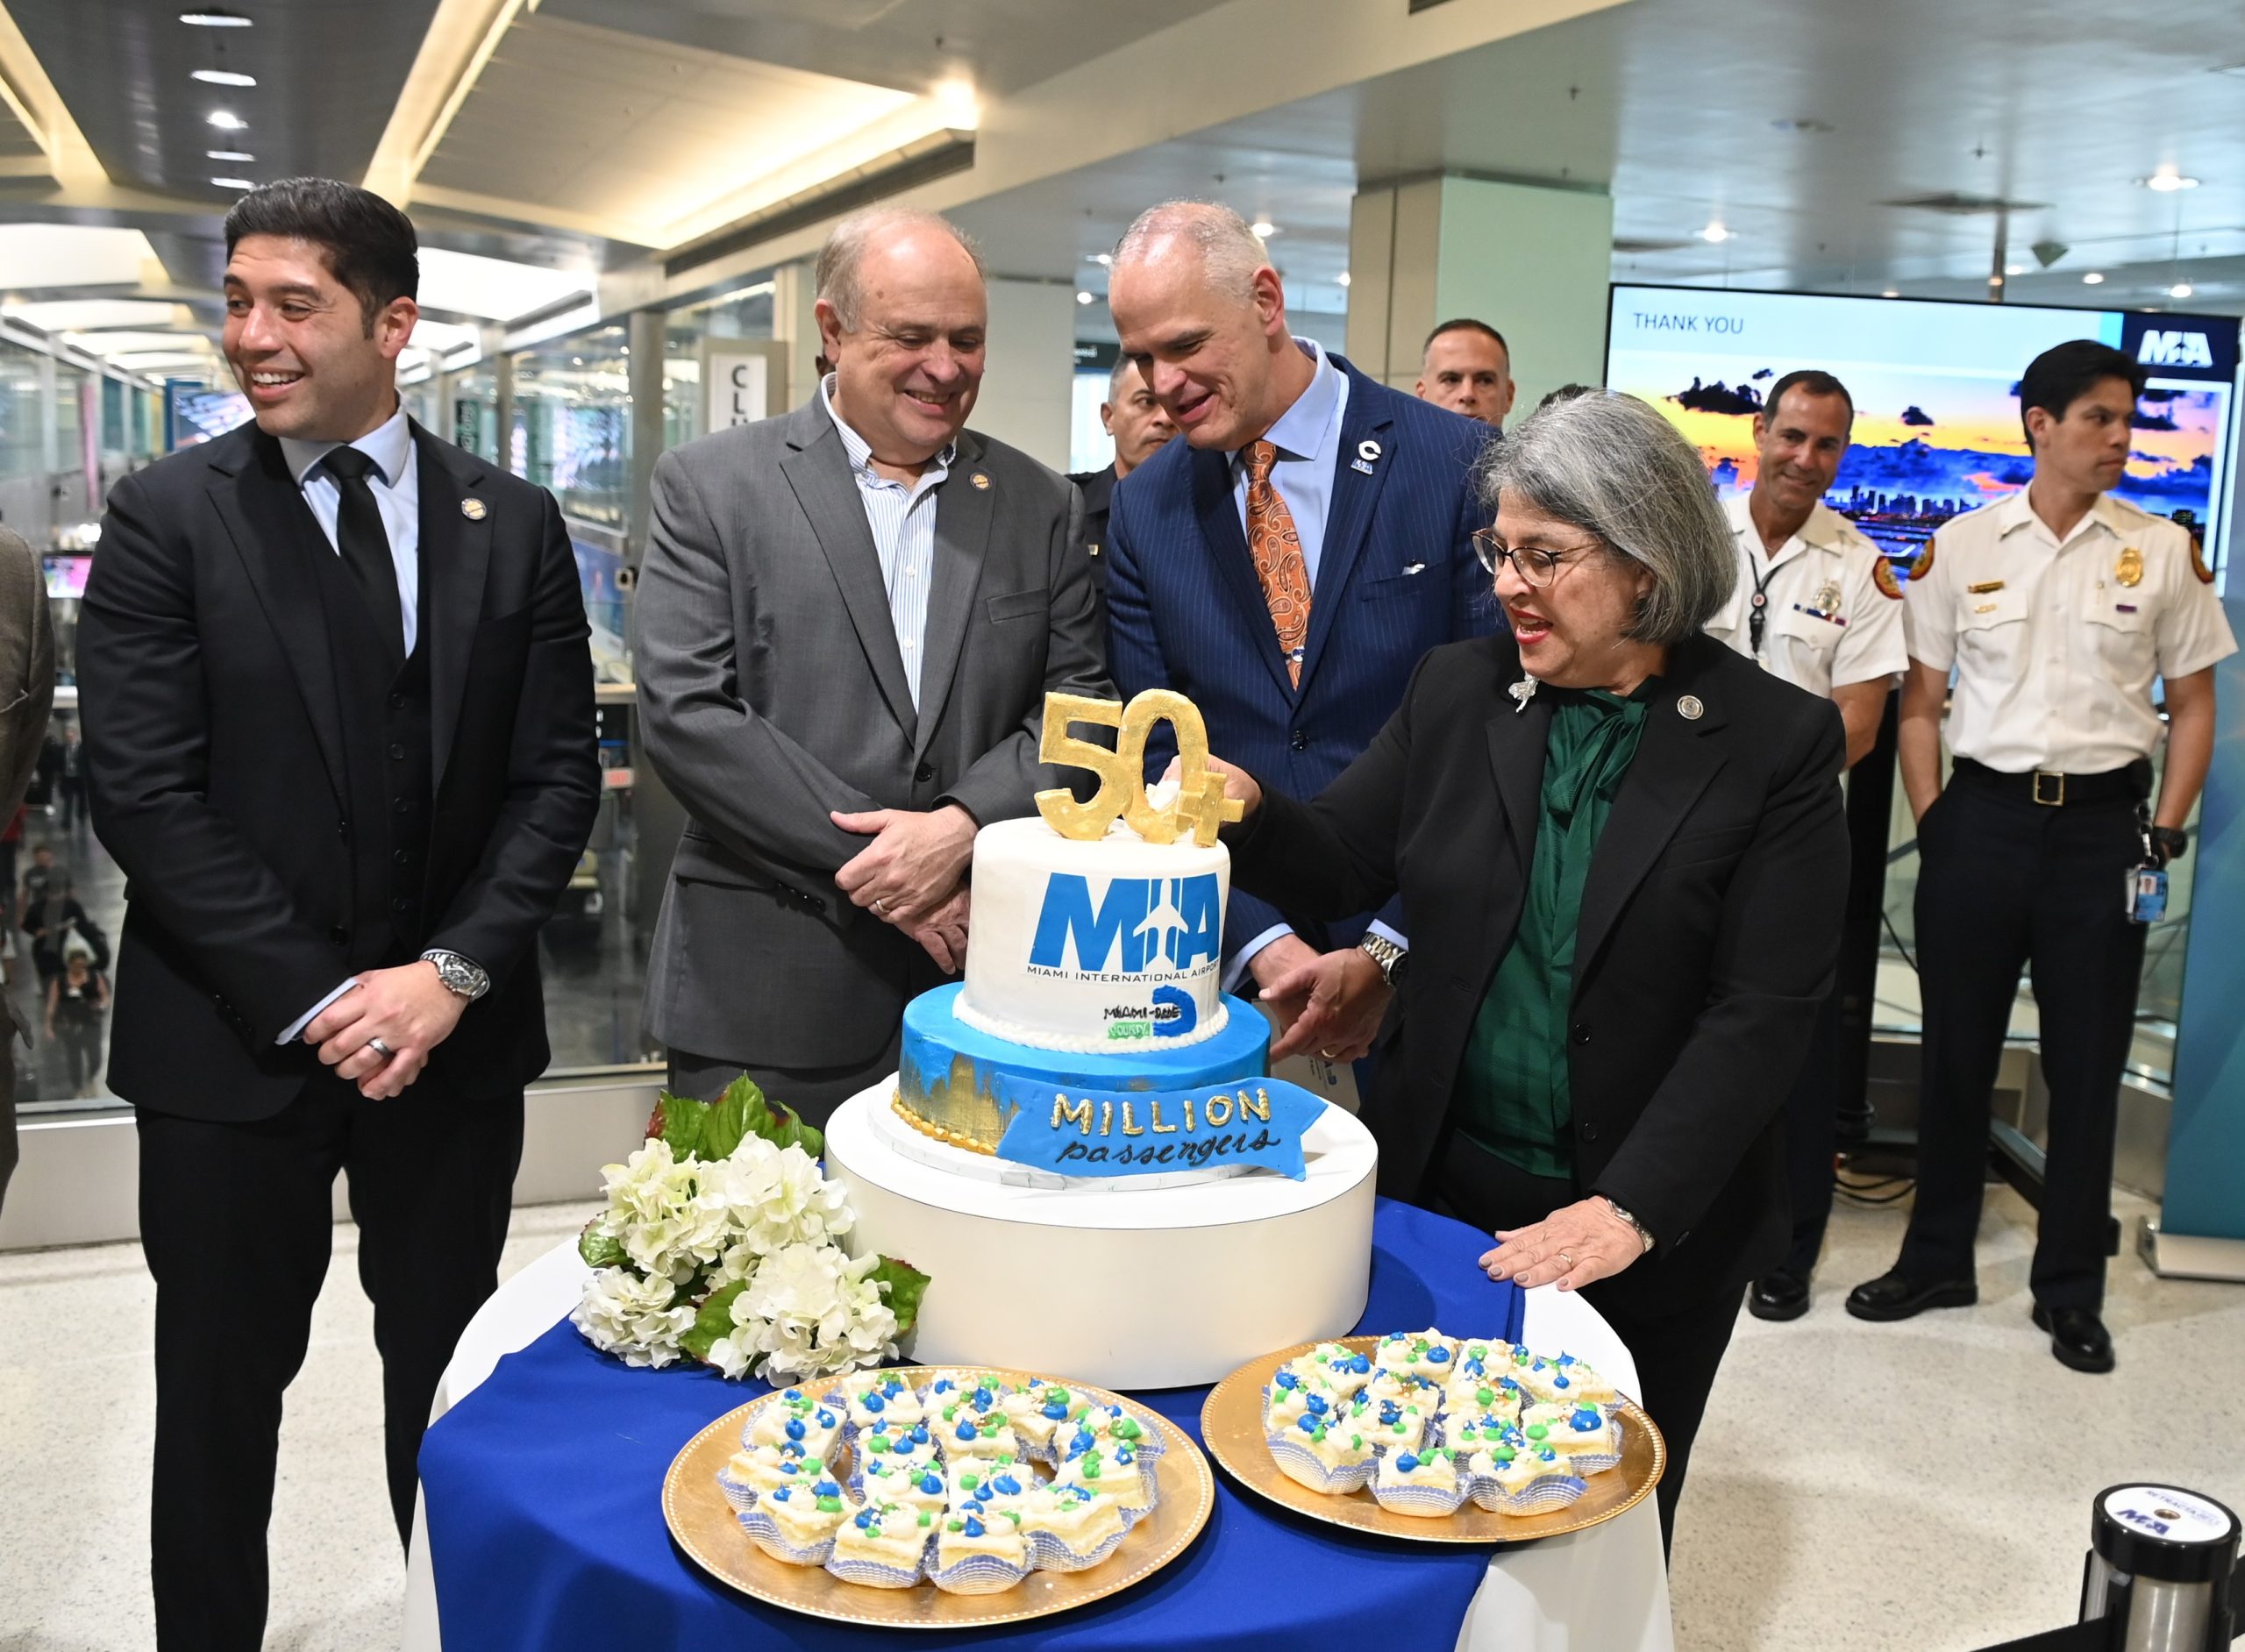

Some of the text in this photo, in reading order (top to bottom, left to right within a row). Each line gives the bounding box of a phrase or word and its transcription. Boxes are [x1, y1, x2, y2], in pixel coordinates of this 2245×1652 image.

[1633, 311, 1744, 335] THANK YOU
[2137, 329, 2213, 367] MIA
[1033, 687, 1246, 849] 50+
[1029, 872, 1221, 973] MIA
[1027, 965, 1069, 979] MIAMI
[1075, 972, 1187, 983] INTERNATIONAL
[1050, 1087, 1272, 1136] MILLION
[1055, 1128, 1281, 1167] passengers
